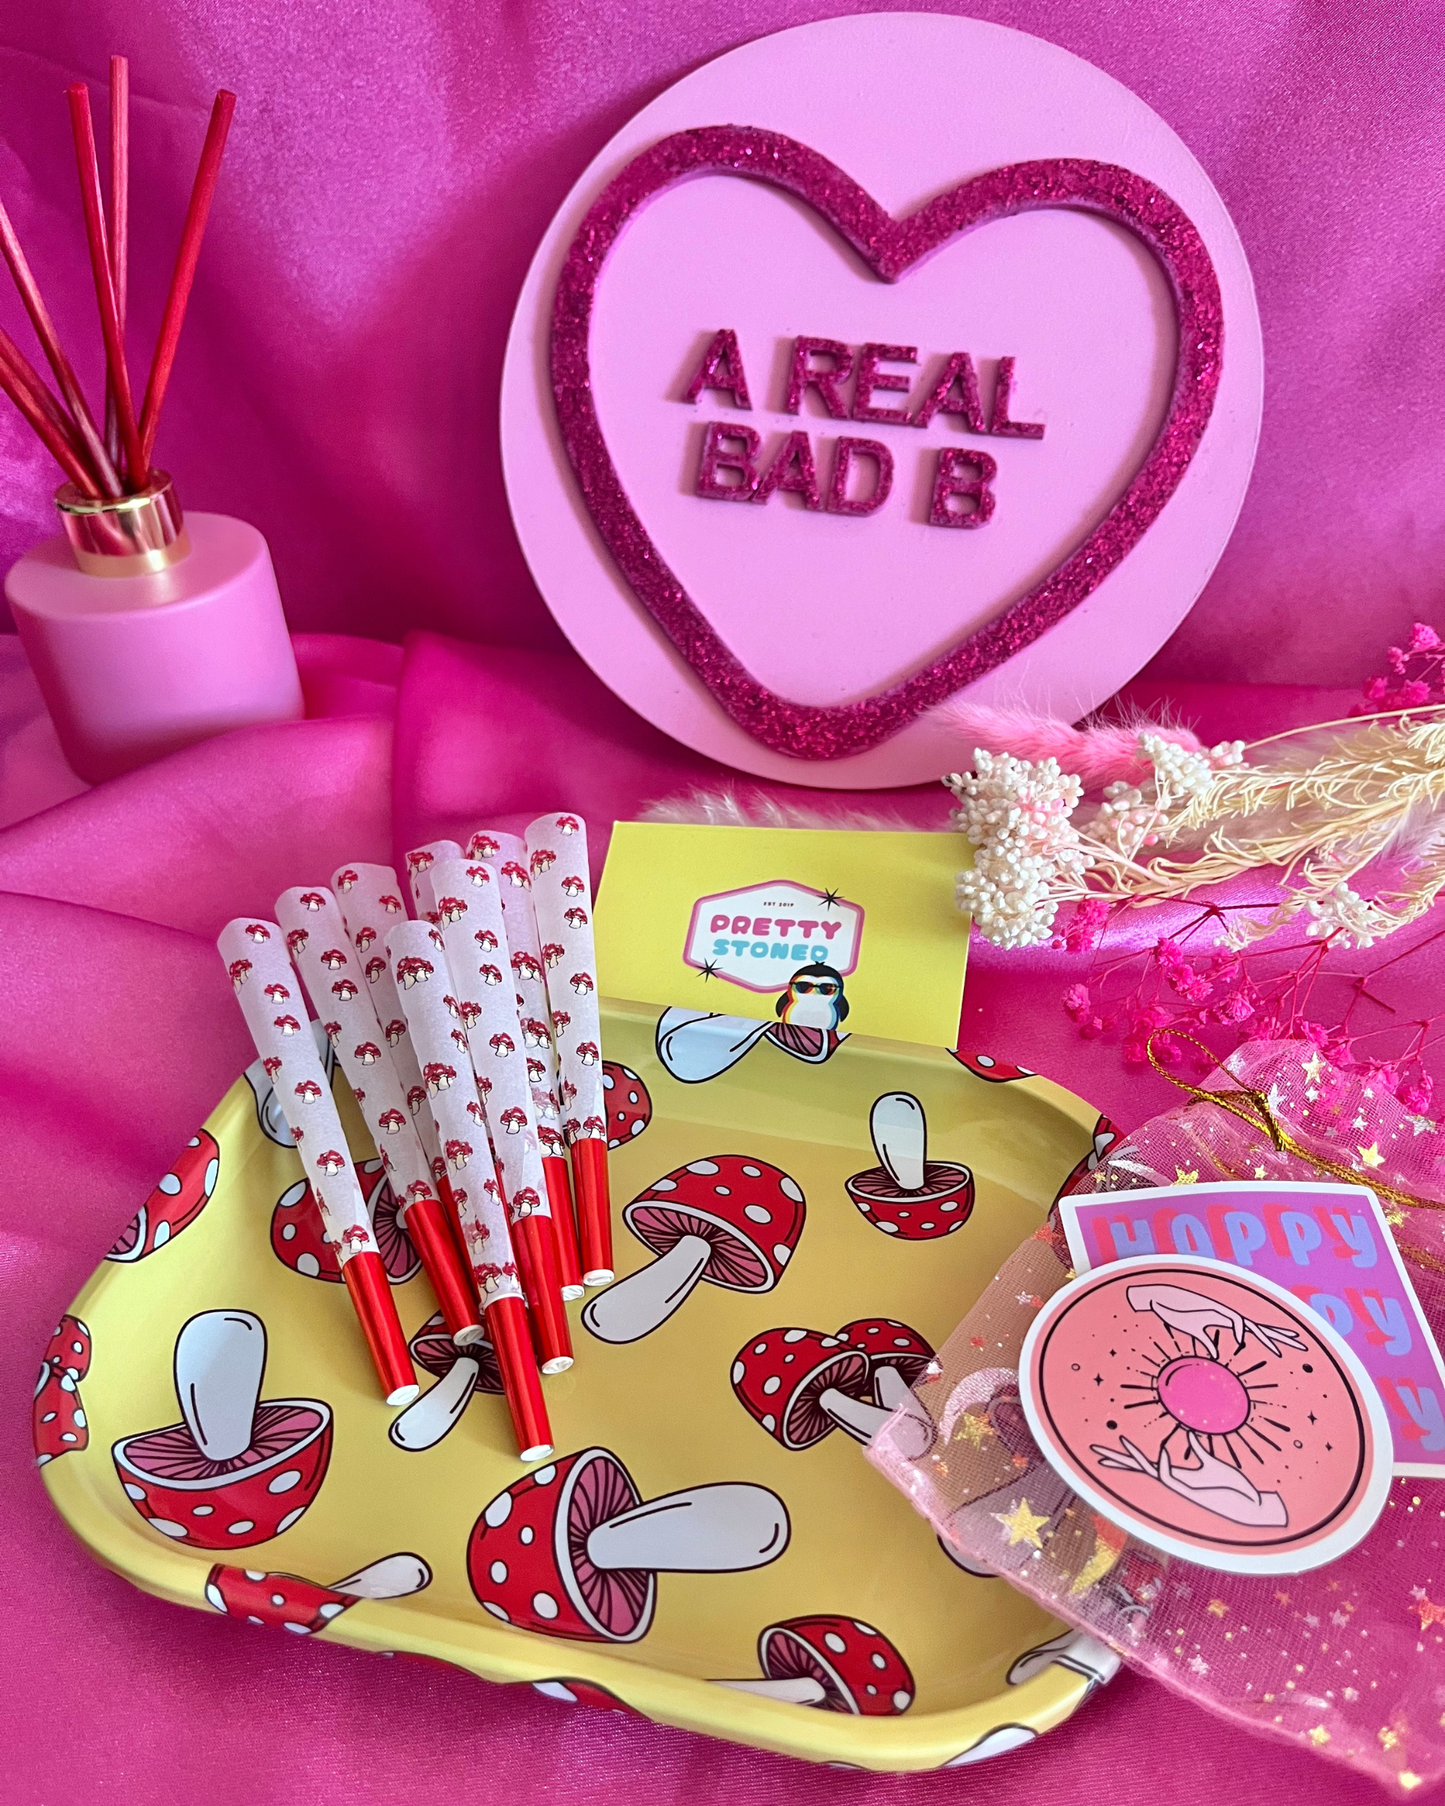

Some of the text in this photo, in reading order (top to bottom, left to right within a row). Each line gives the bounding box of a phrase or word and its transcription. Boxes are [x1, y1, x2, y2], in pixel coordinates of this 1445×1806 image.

[684, 328, 1046, 440] A REAL
[696, 420, 998, 530] BAD B
[710, 914, 842, 940] PRETTY
[712, 938, 829, 962] STONED
[1092, 1203, 1378, 1269] HAPPY
